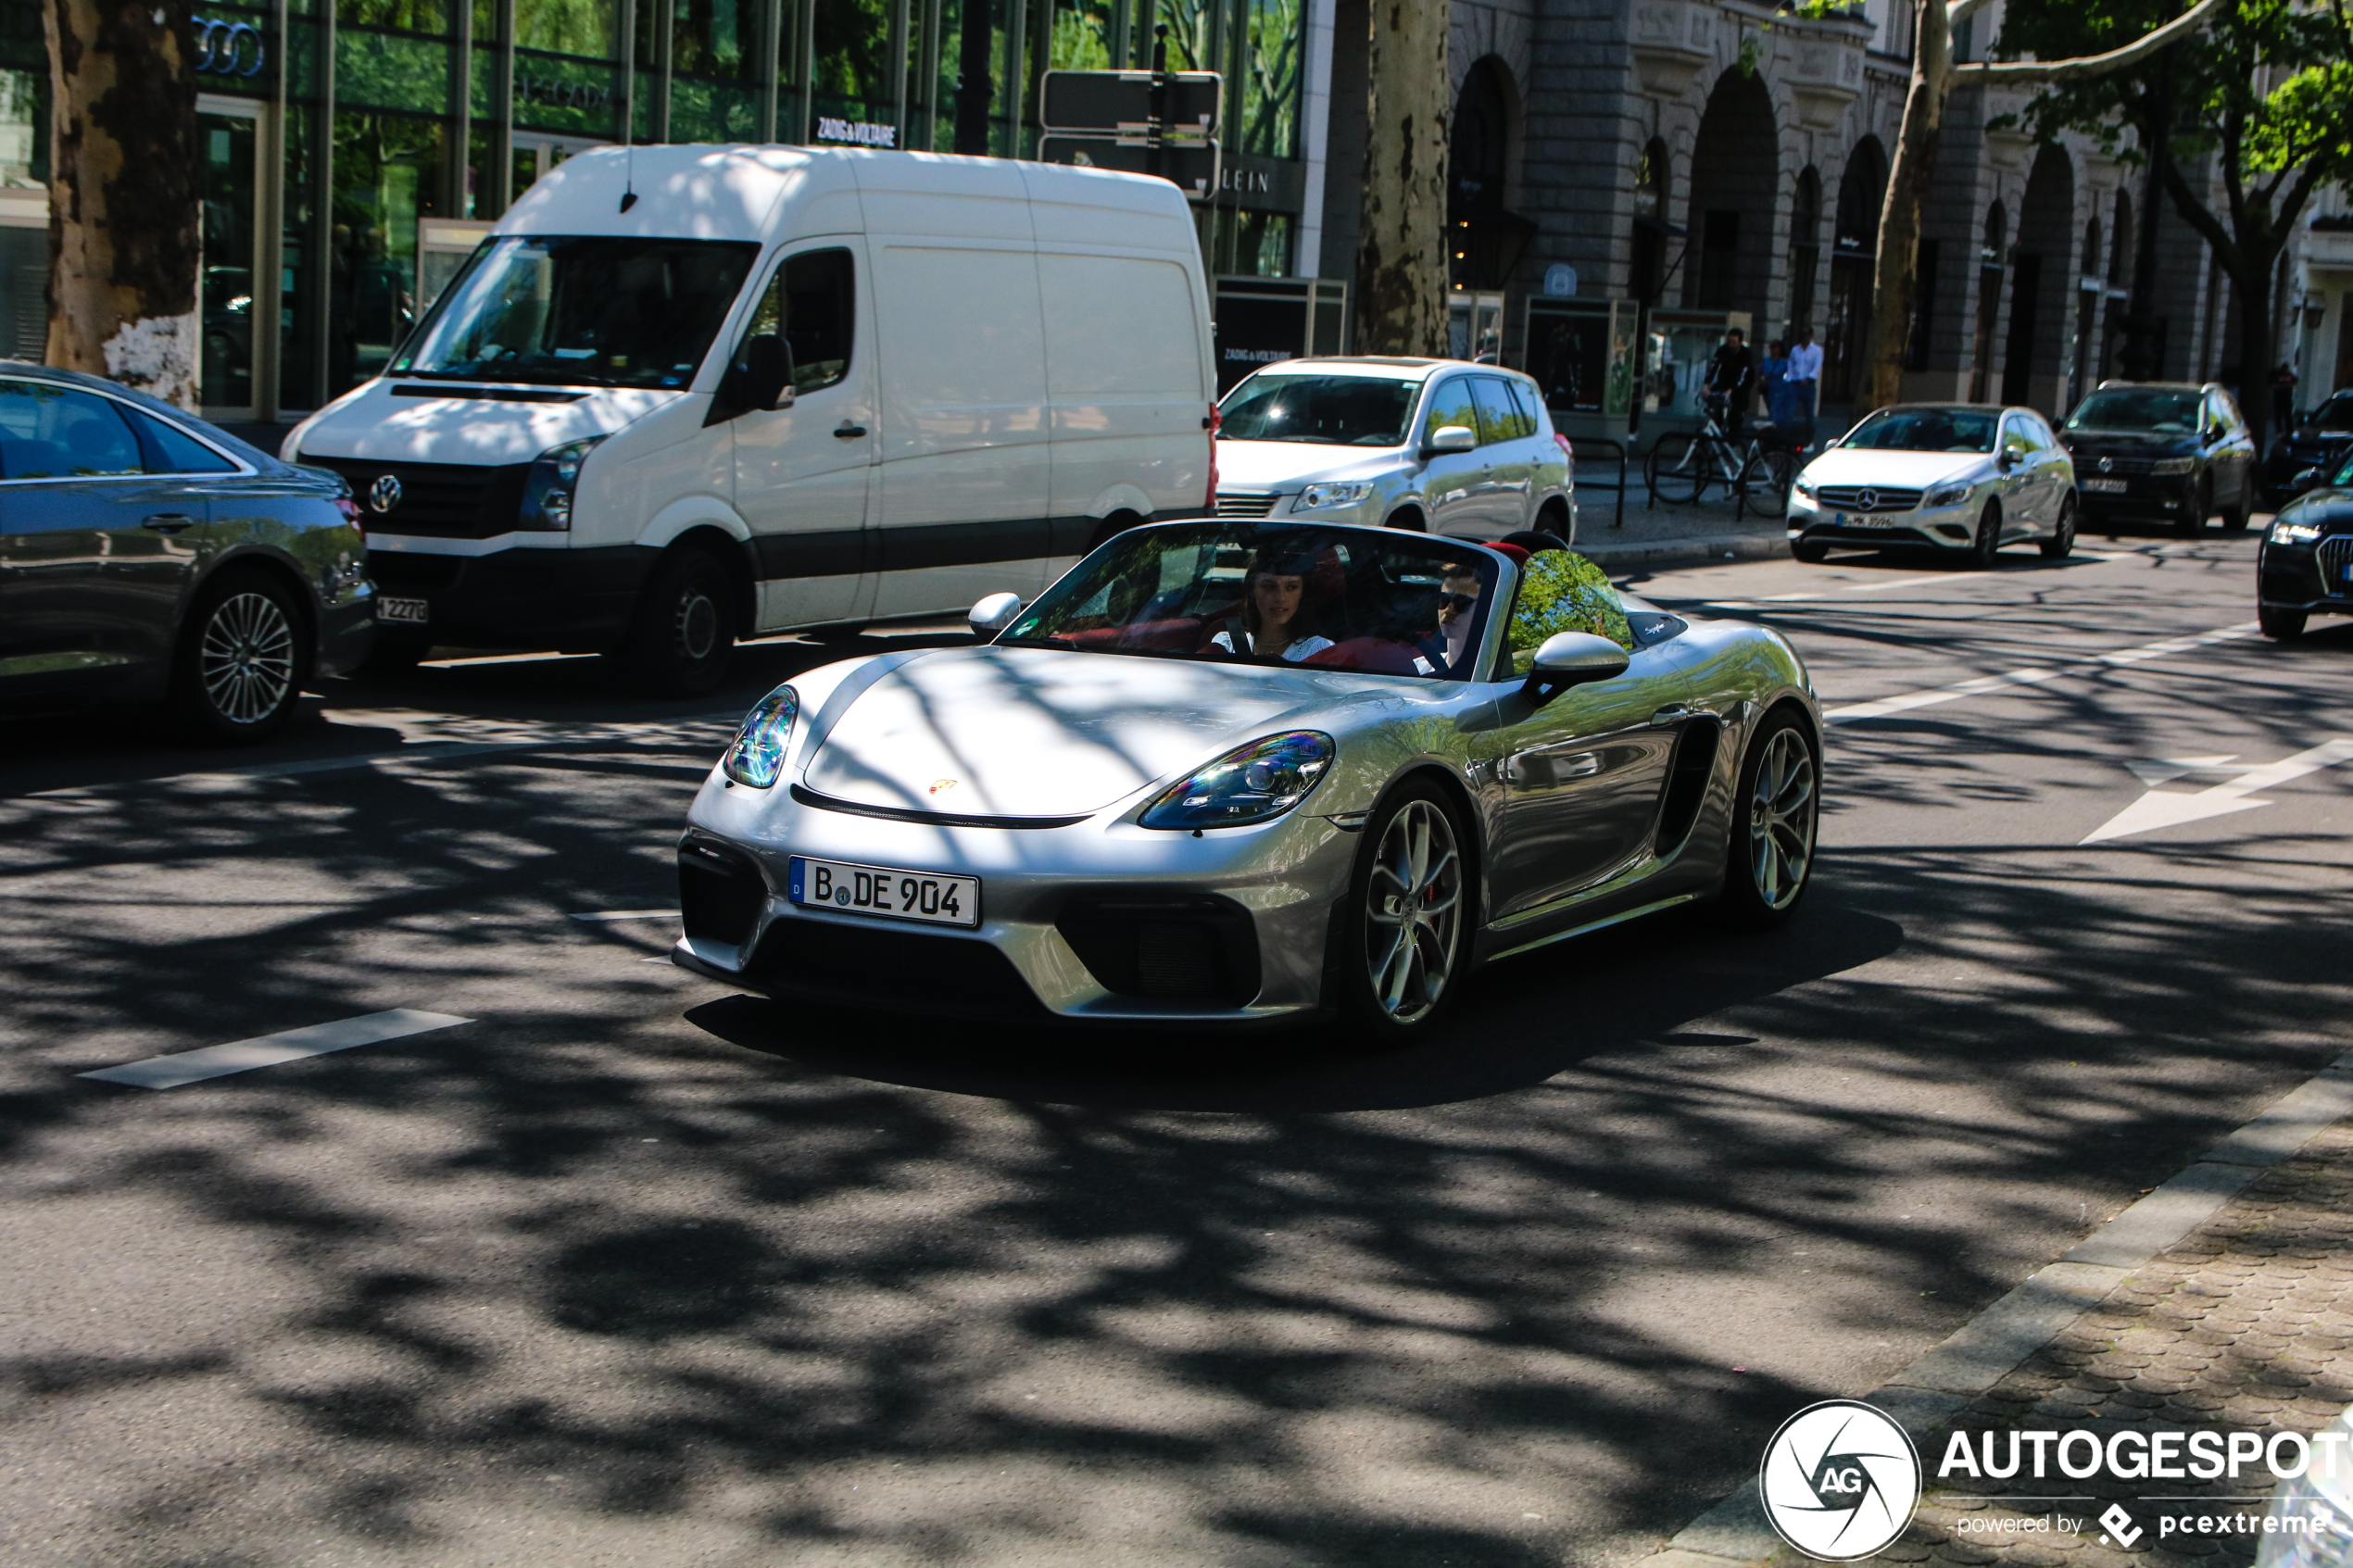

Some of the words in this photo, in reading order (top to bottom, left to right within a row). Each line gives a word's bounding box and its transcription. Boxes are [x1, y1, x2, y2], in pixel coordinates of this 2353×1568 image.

[815, 866, 833, 900] B
[853, 872, 892, 909] DE
[900, 877, 960, 918] 904
